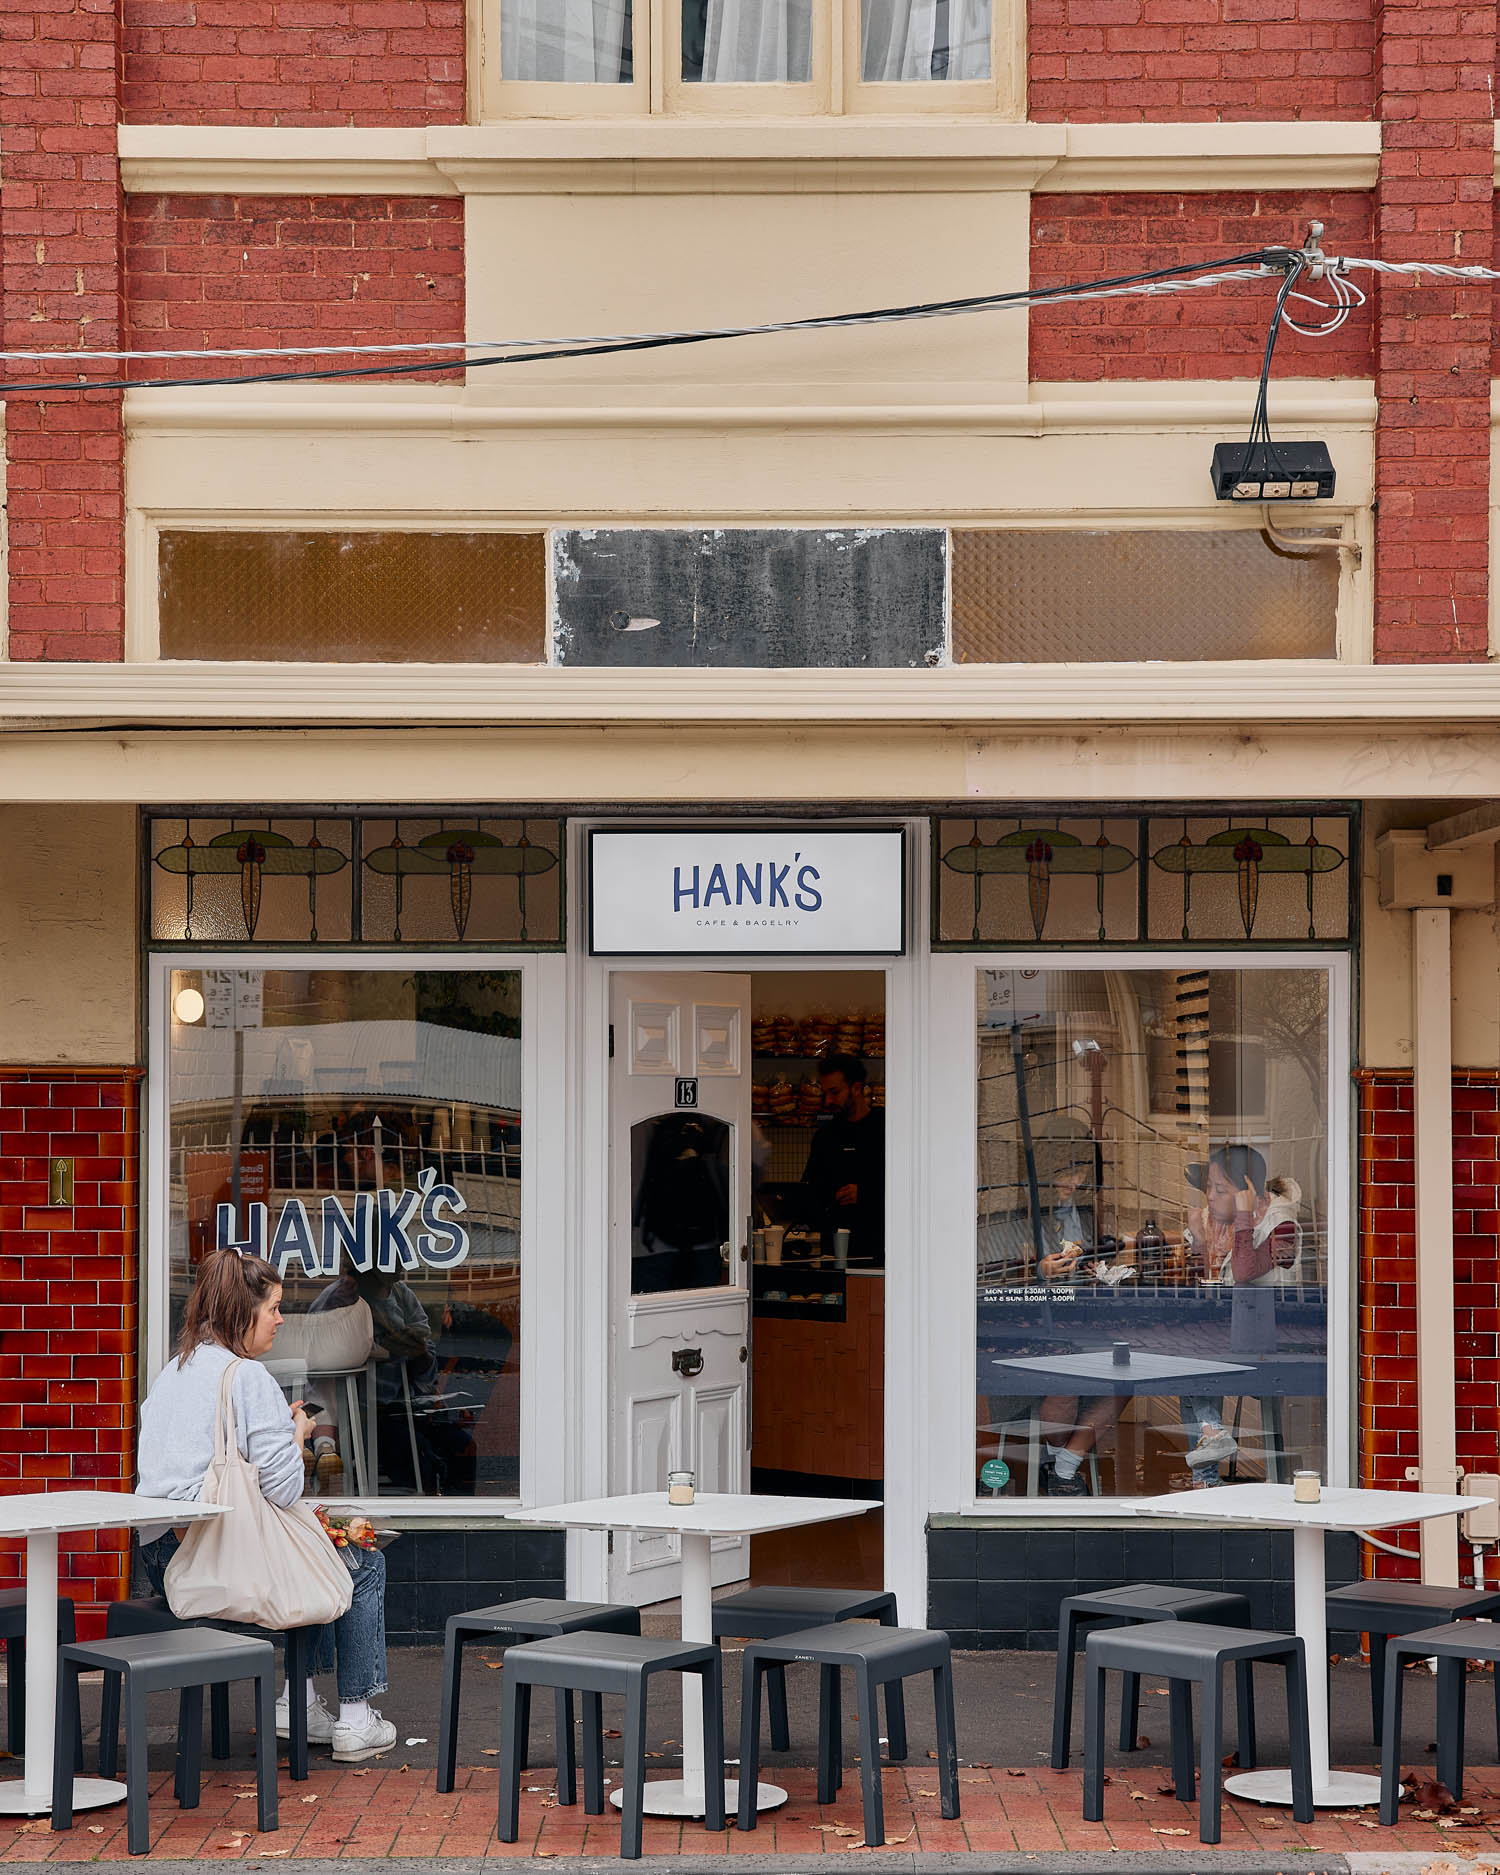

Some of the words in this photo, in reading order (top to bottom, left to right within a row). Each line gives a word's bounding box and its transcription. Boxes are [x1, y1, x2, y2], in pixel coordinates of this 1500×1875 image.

[674, 852, 822, 912] HANK'S
[680, 1082, 693, 1104] 13
[217, 1166, 470, 1281] HANK'S
